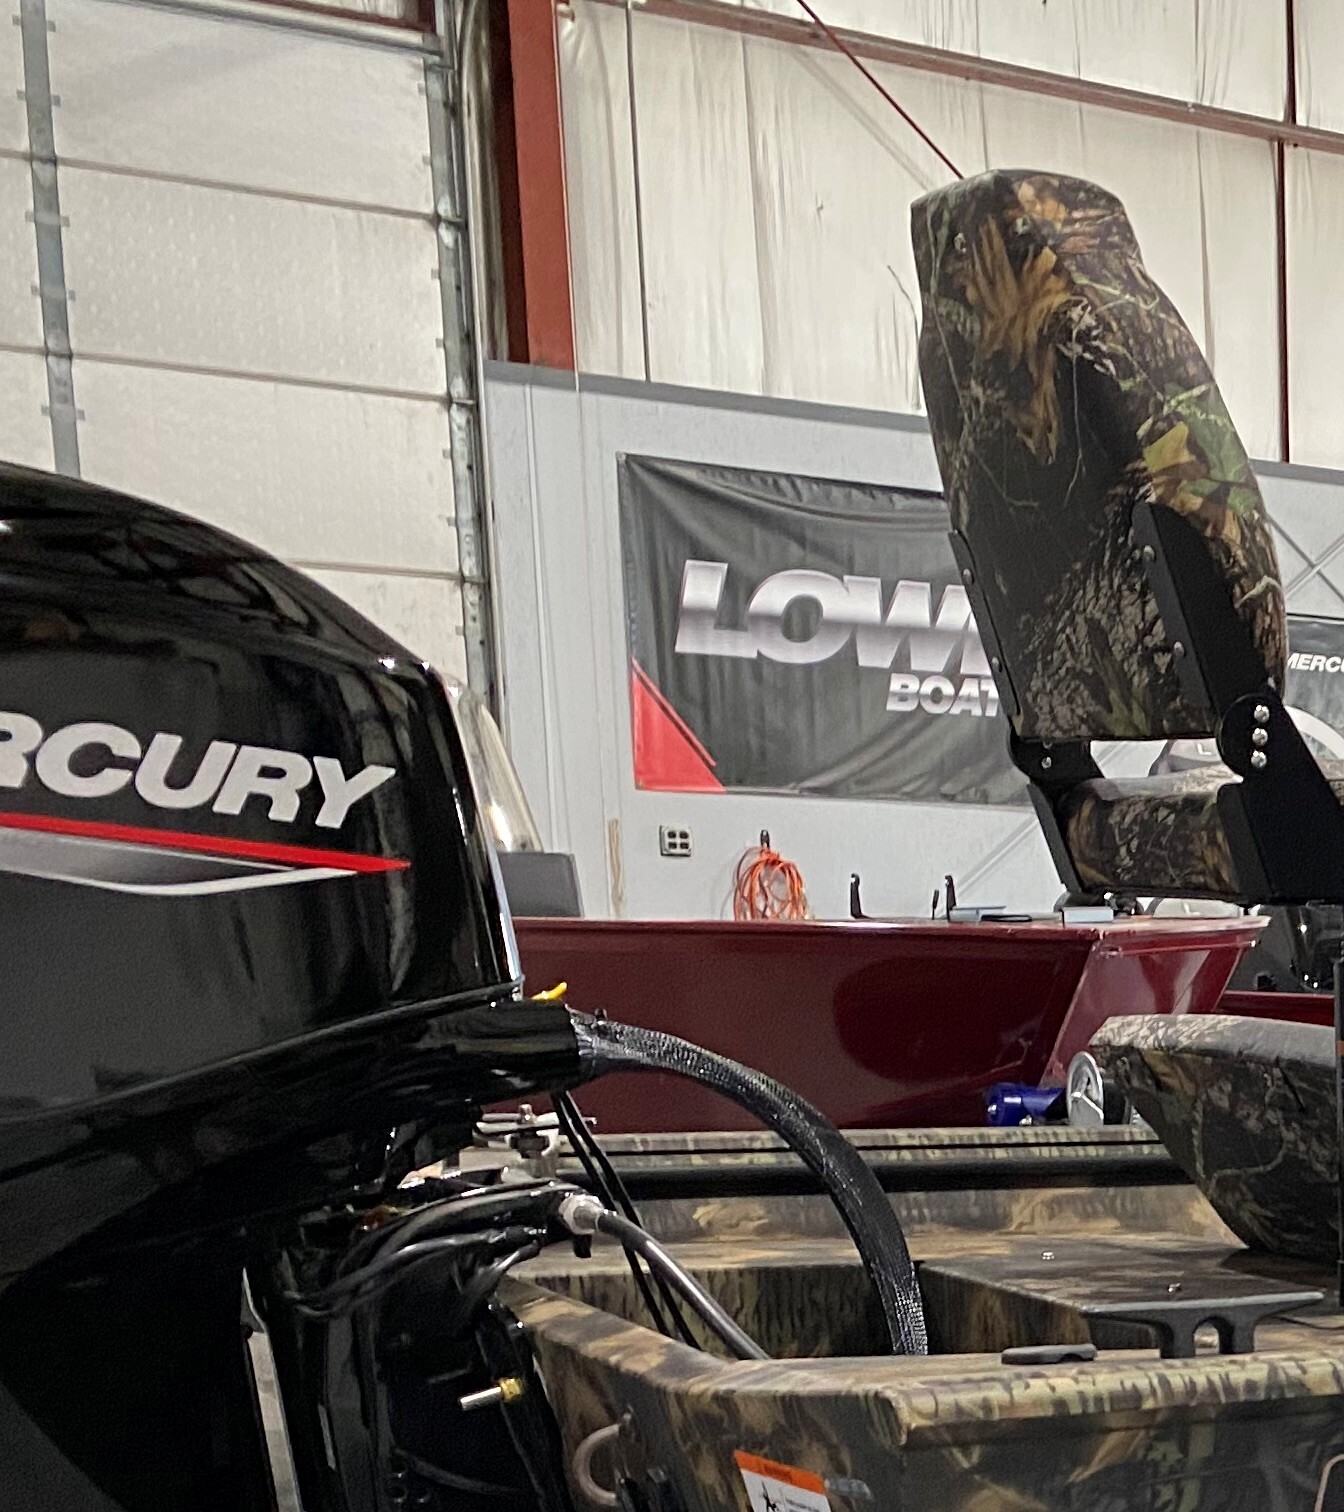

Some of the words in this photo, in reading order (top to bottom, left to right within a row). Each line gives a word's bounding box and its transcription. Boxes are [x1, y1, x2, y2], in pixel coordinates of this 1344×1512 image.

[675, 559, 991, 676] LOW
[886, 673, 1000, 717] BOAT
[0, 711, 396, 829] RCURY
